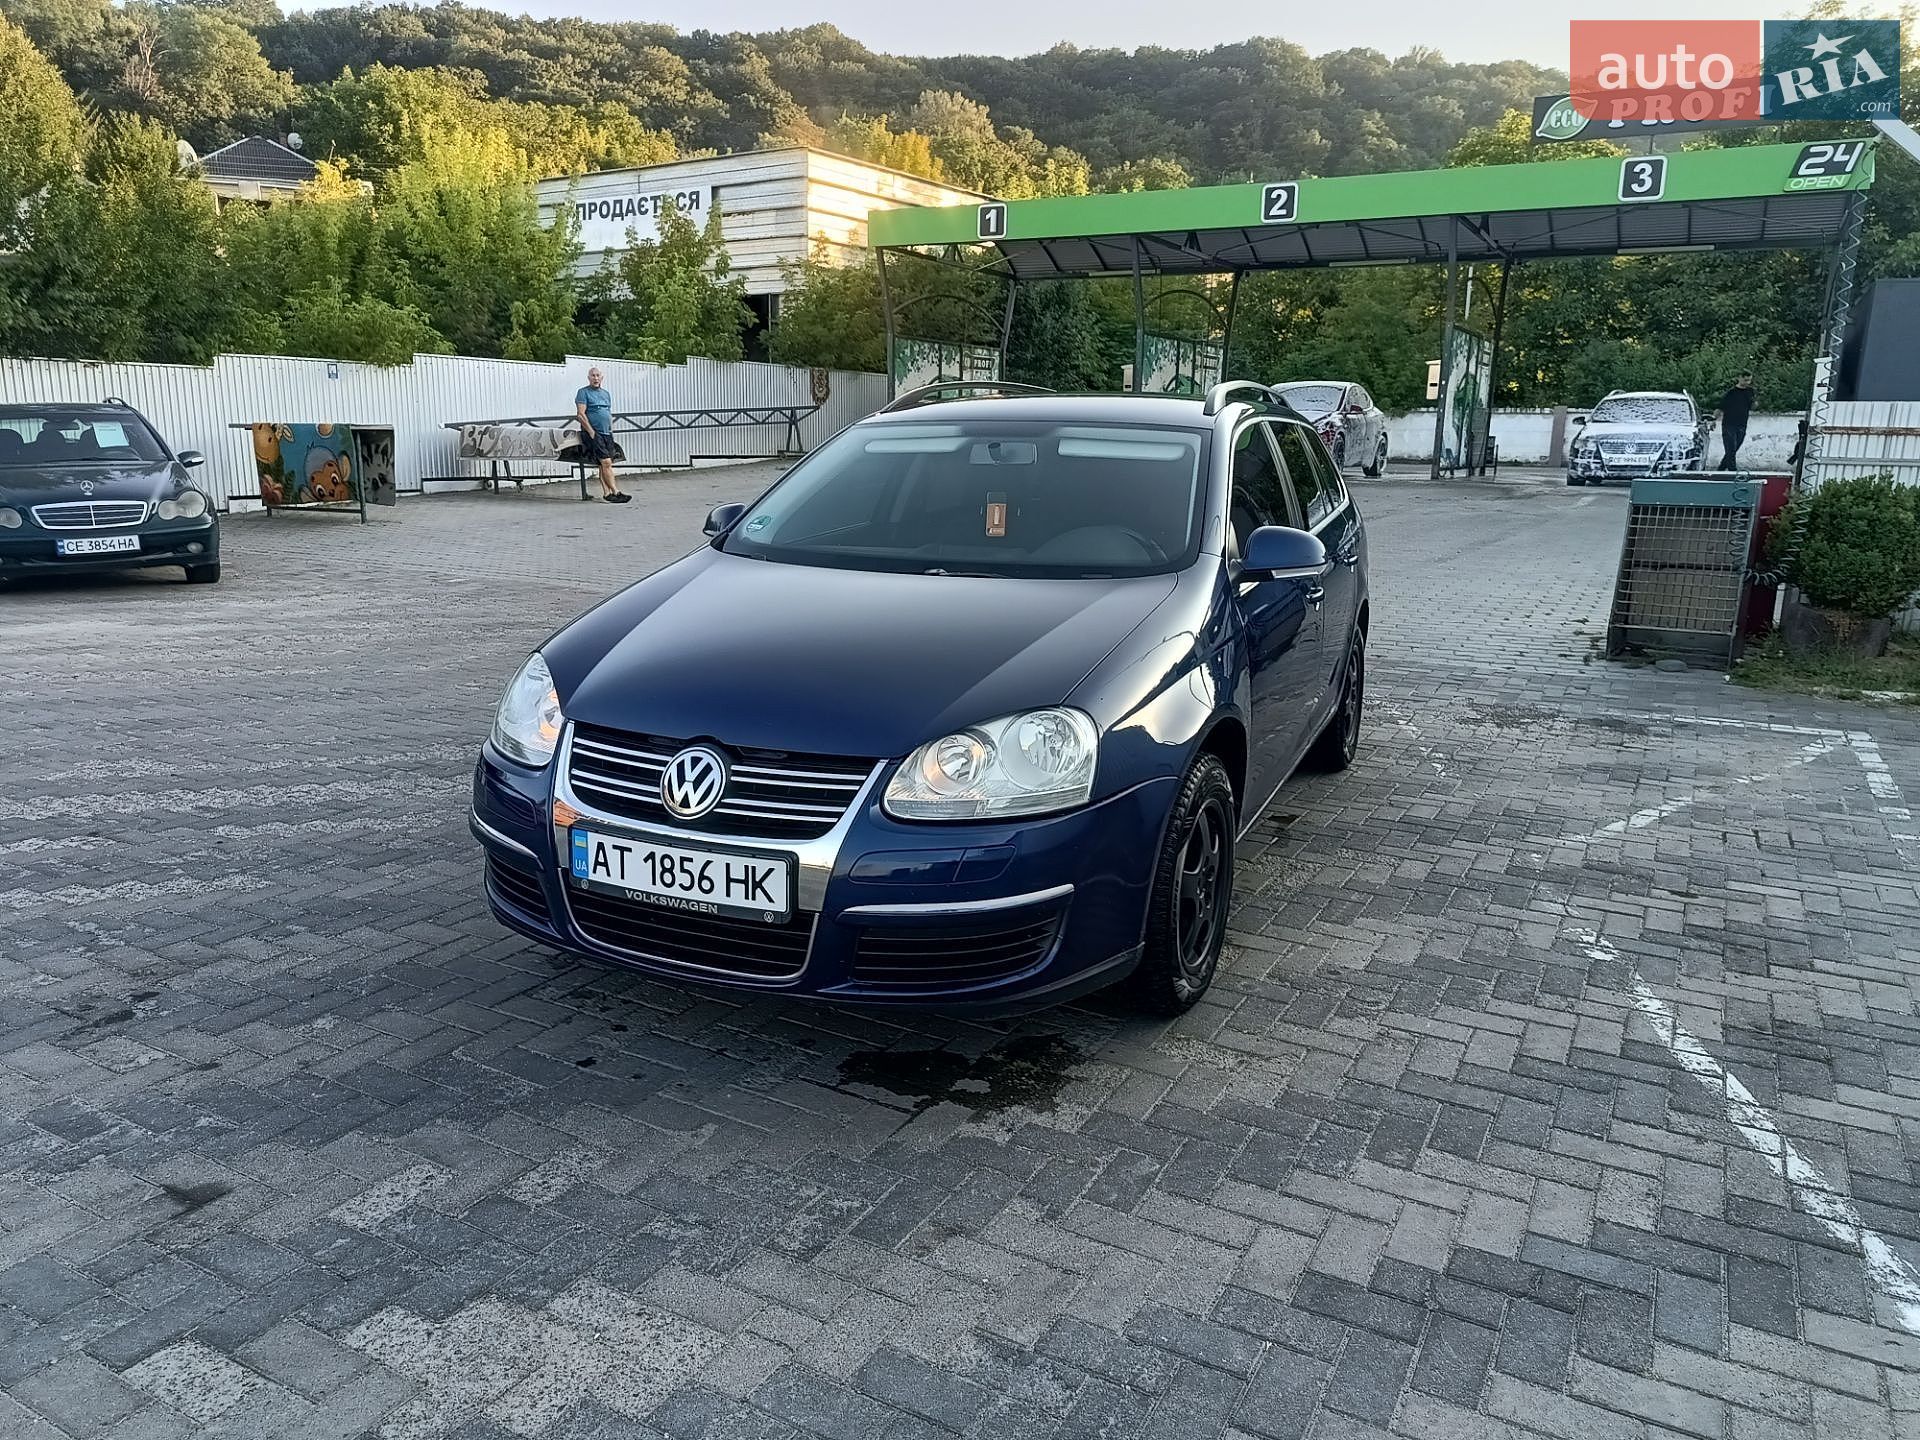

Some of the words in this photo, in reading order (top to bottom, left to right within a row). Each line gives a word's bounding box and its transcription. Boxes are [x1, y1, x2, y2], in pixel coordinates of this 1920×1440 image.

[1551, 108, 1581, 129] eco
[1798, 142, 1864, 176] 24
[1631, 162, 1653, 194] 3
[1790, 176, 1847, 189] OPEN
[575, 190, 701, 222] ПРОДАЄТСЯ
[1268, 189, 1288, 216] 2
[984, 209, 999, 233] 1
[66, 541, 84, 552] CE
[88, 540, 115, 551] 3854
[118, 538, 135, 549] HA
[663, 749, 724, 817] VW
[575, 857, 588, 872] UA
[592, 841, 632, 880] AT
[643, 851, 715, 895] 1856
[725, 862, 775, 904] HK
[624, 889, 718, 914] VOLKSWAGEN
